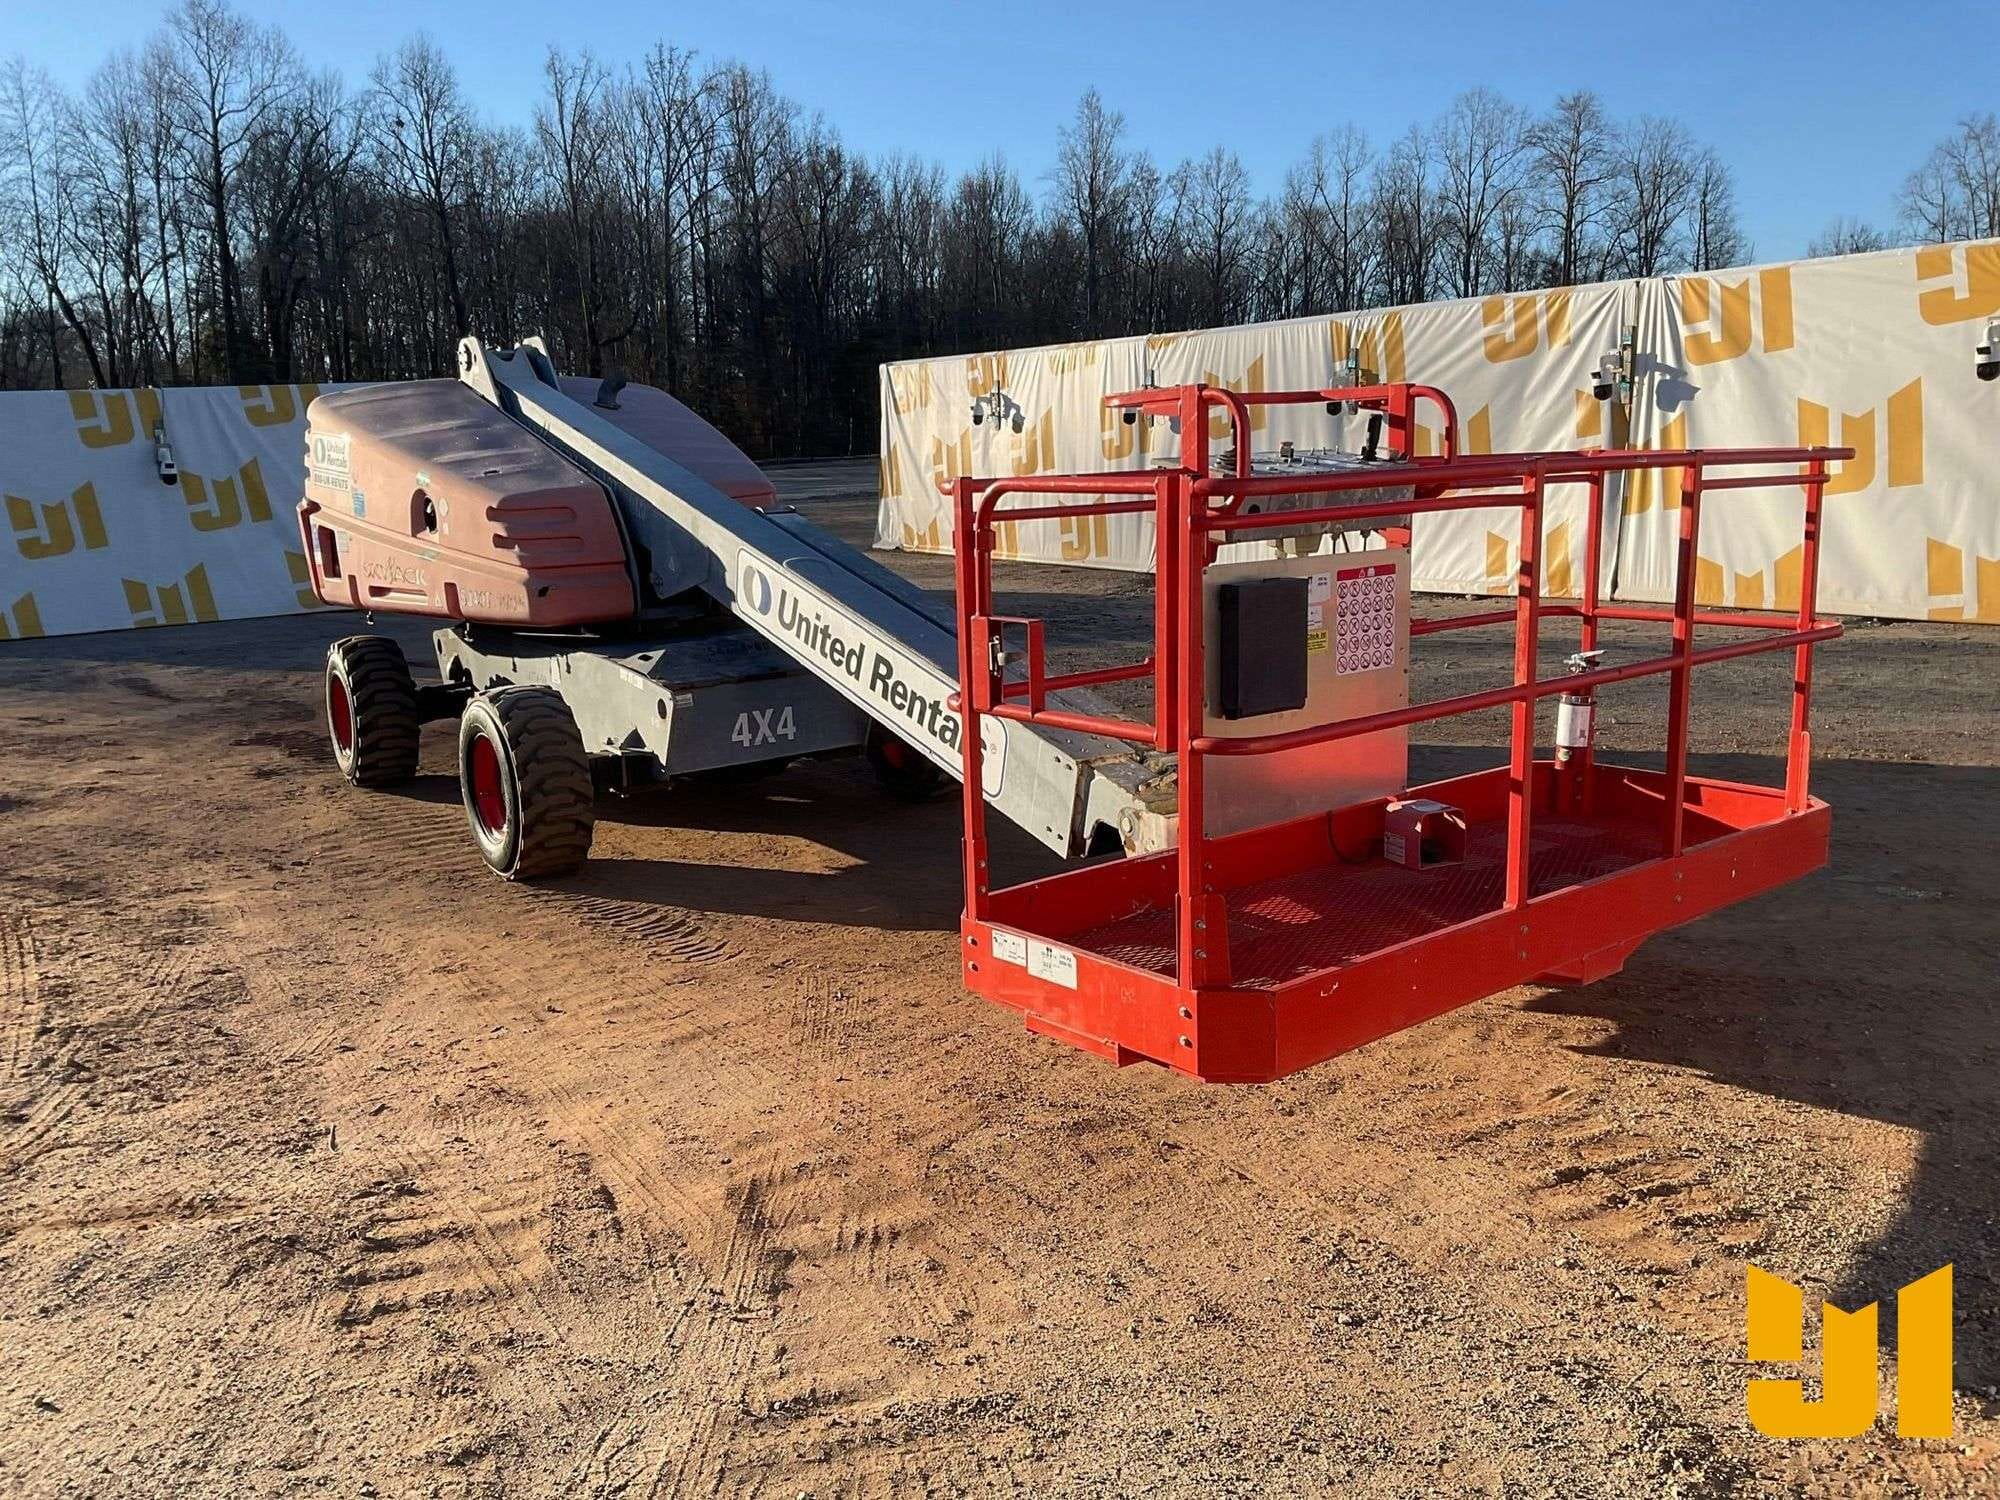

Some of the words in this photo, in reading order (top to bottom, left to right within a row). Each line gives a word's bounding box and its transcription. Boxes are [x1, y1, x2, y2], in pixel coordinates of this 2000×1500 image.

[731, 706, 797, 748] 4X4
[777, 588, 866, 682] United
[868, 652, 987, 767] Renta
